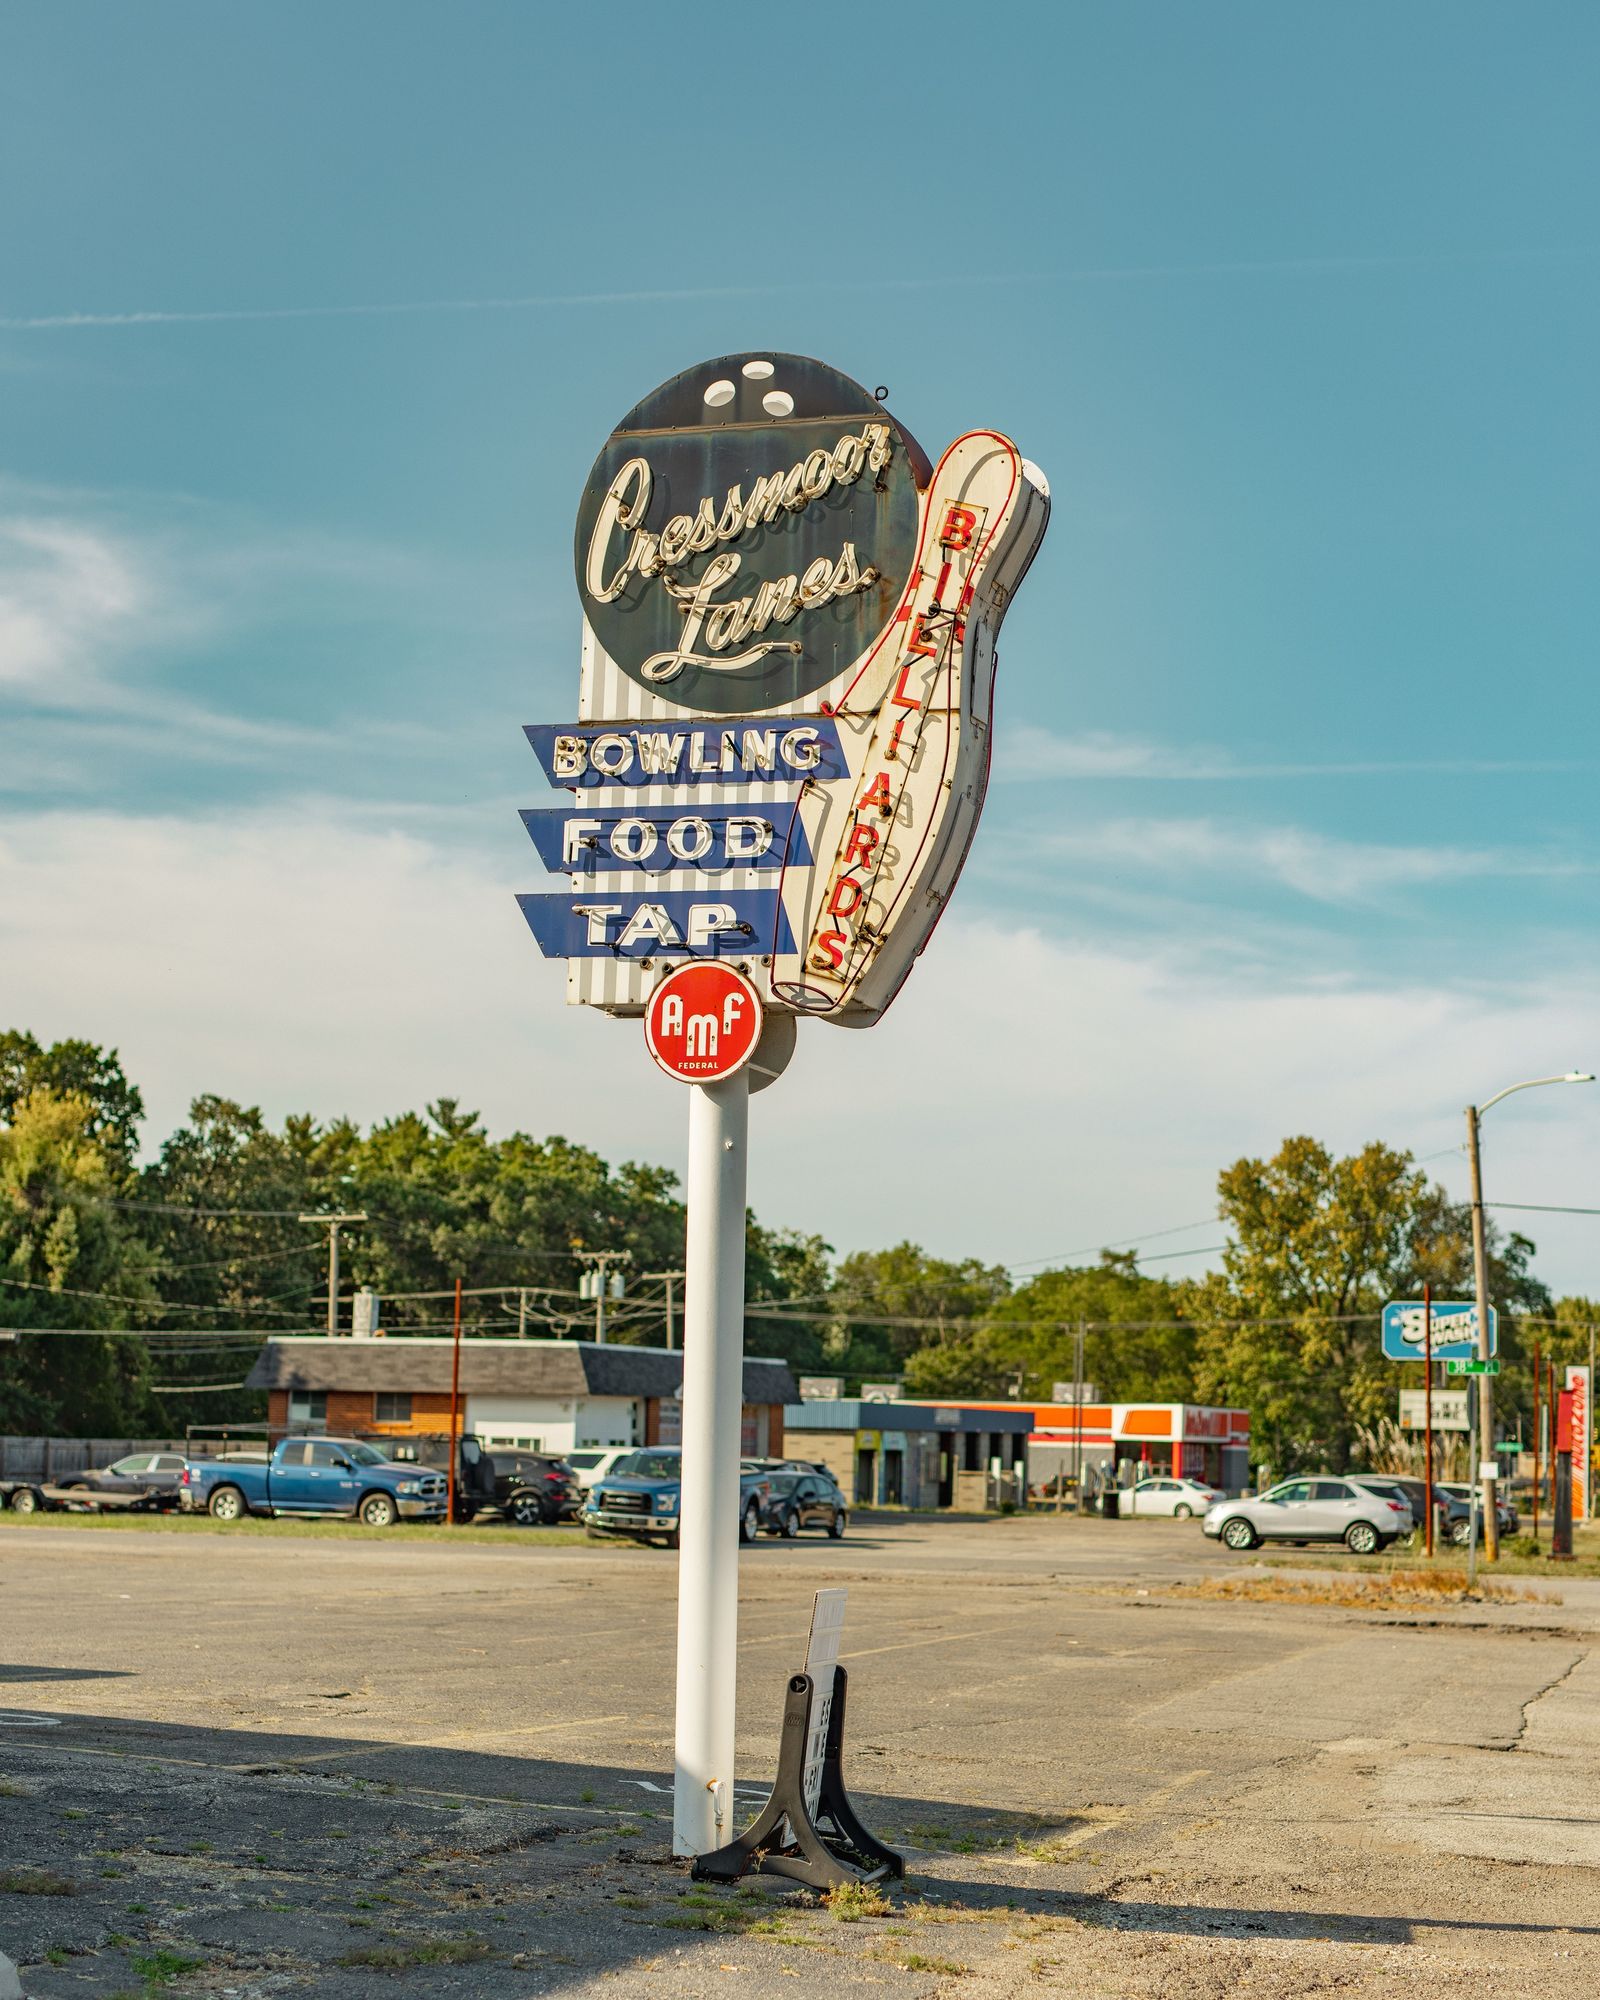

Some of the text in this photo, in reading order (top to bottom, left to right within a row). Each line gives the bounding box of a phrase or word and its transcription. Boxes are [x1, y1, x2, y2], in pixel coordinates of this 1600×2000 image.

[586, 424, 891, 603] Cressmoor
[640, 542, 880, 684] Lanes
[553, 728, 822, 778] BOWLING
[810, 507, 977, 971] BILLIARDS
[563, 816, 774, 864] FOOD
[573, 903, 744, 947] TAP
